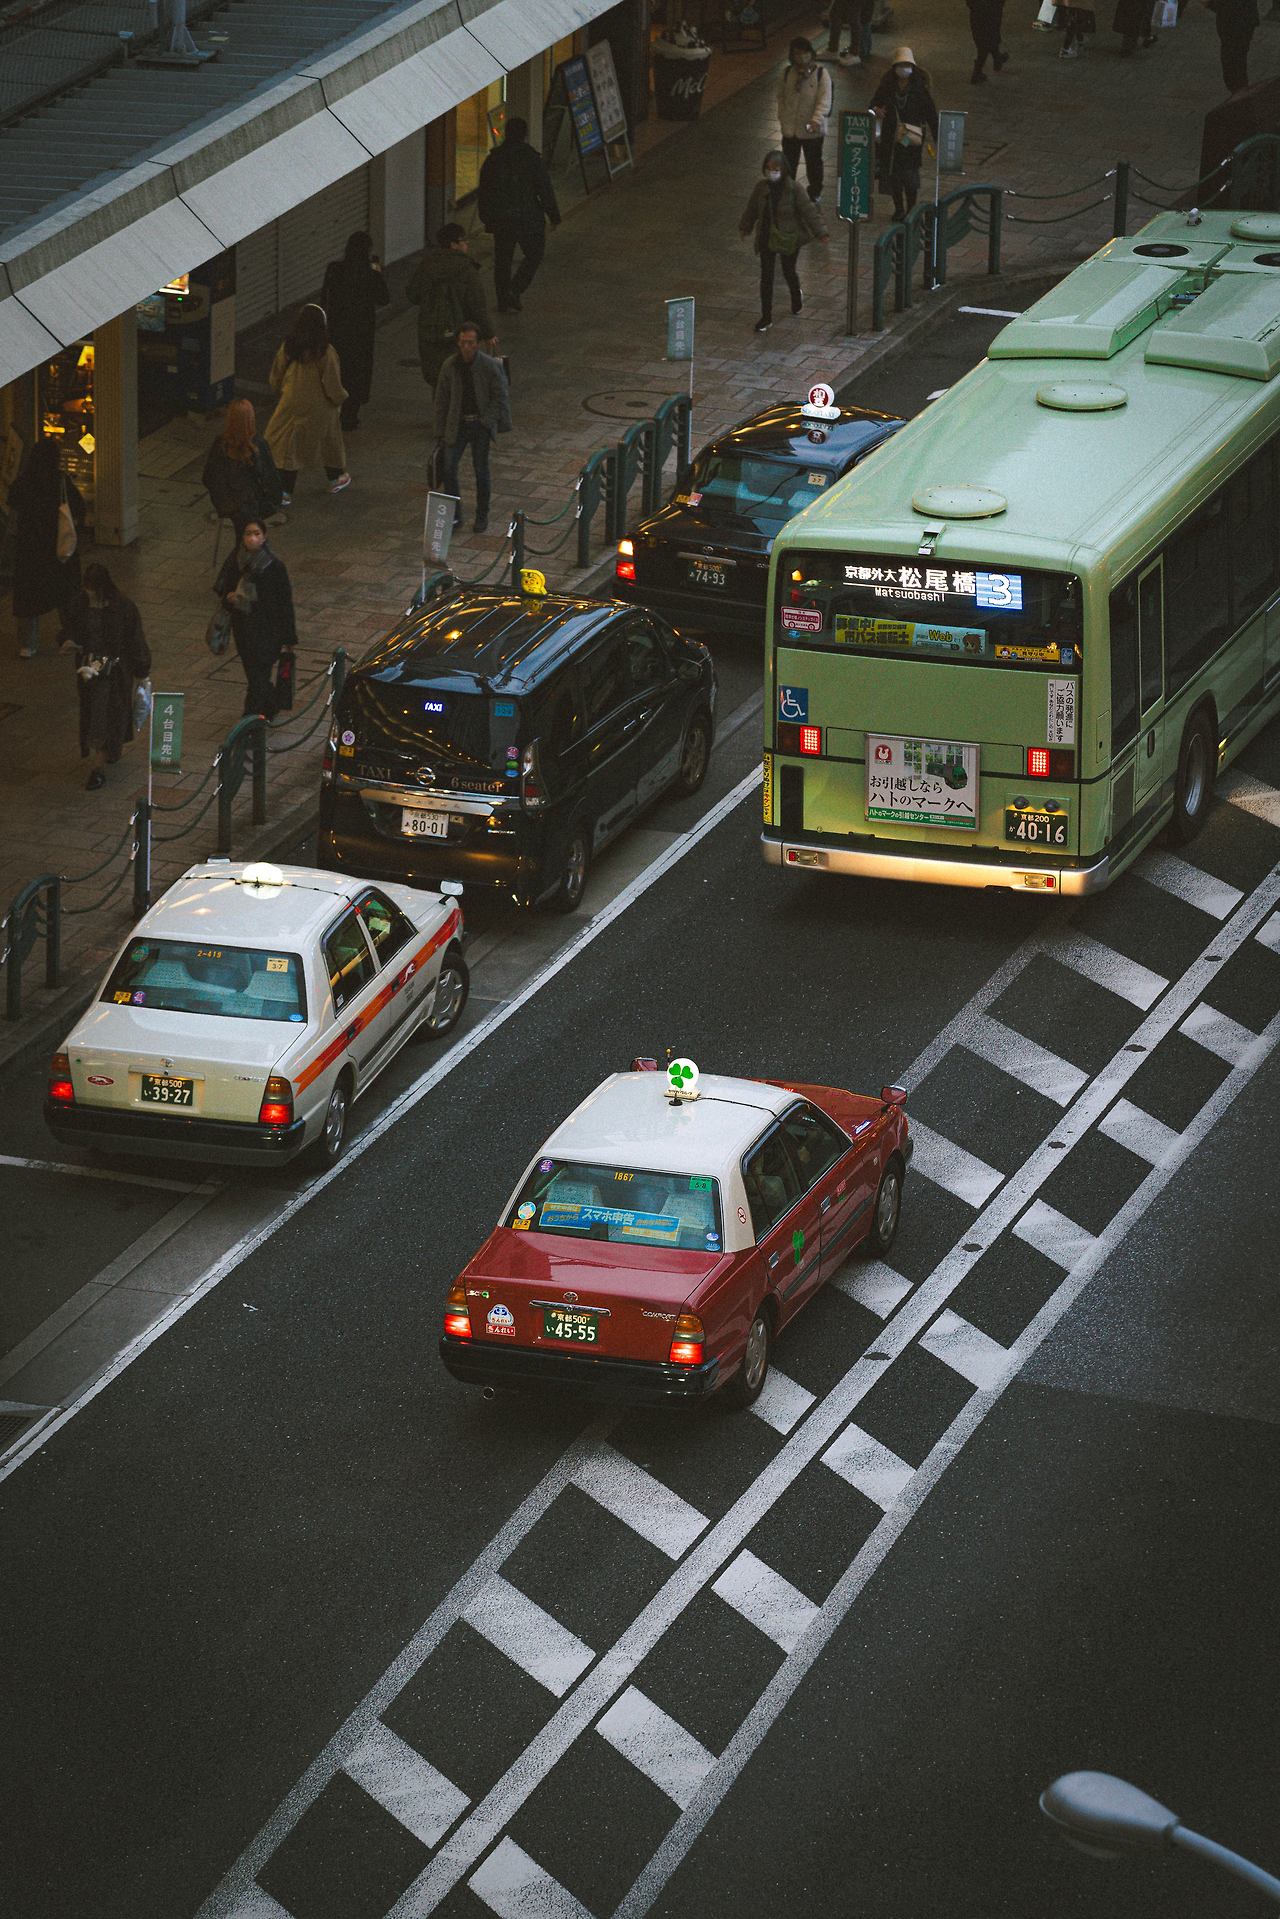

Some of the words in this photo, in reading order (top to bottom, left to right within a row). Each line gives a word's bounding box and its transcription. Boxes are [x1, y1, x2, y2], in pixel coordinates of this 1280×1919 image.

[847, 117, 870, 127] TAXI
[850, 147, 866, 216] タクシーのりば
[696, 570, 725, 585] 74-93
[845, 565, 897, 584] 京都外大
[898, 565, 976, 594] 松尾橋
[874, 586, 945, 602] Matsuobashi
[988, 573, 1013, 606] 3
[928, 629, 953, 643] Web
[424, 701, 443, 712] TAXI
[1065, 682, 1074, 728] バスの発進に
[1056, 688, 1065, 742] ご協力願います
[357, 764, 392, 779] TAXI
[451, 776, 460, 788] 6
[461, 779, 504, 795] seater
[869, 775, 943, 794] お引越しなら
[869, 791, 974, 812] ハトのマークへ
[412, 819, 444, 835] 80-01
[1016, 821, 1065, 843] 40-16
[152, 1086, 191, 1104] 39-27
[613, 1172, 634, 1182] 1867
[581, 1207, 635, 1226] スマホ申告
[488, 1325, 514, 1335] きんれい
[555, 1323, 596, 1341] 45-55
